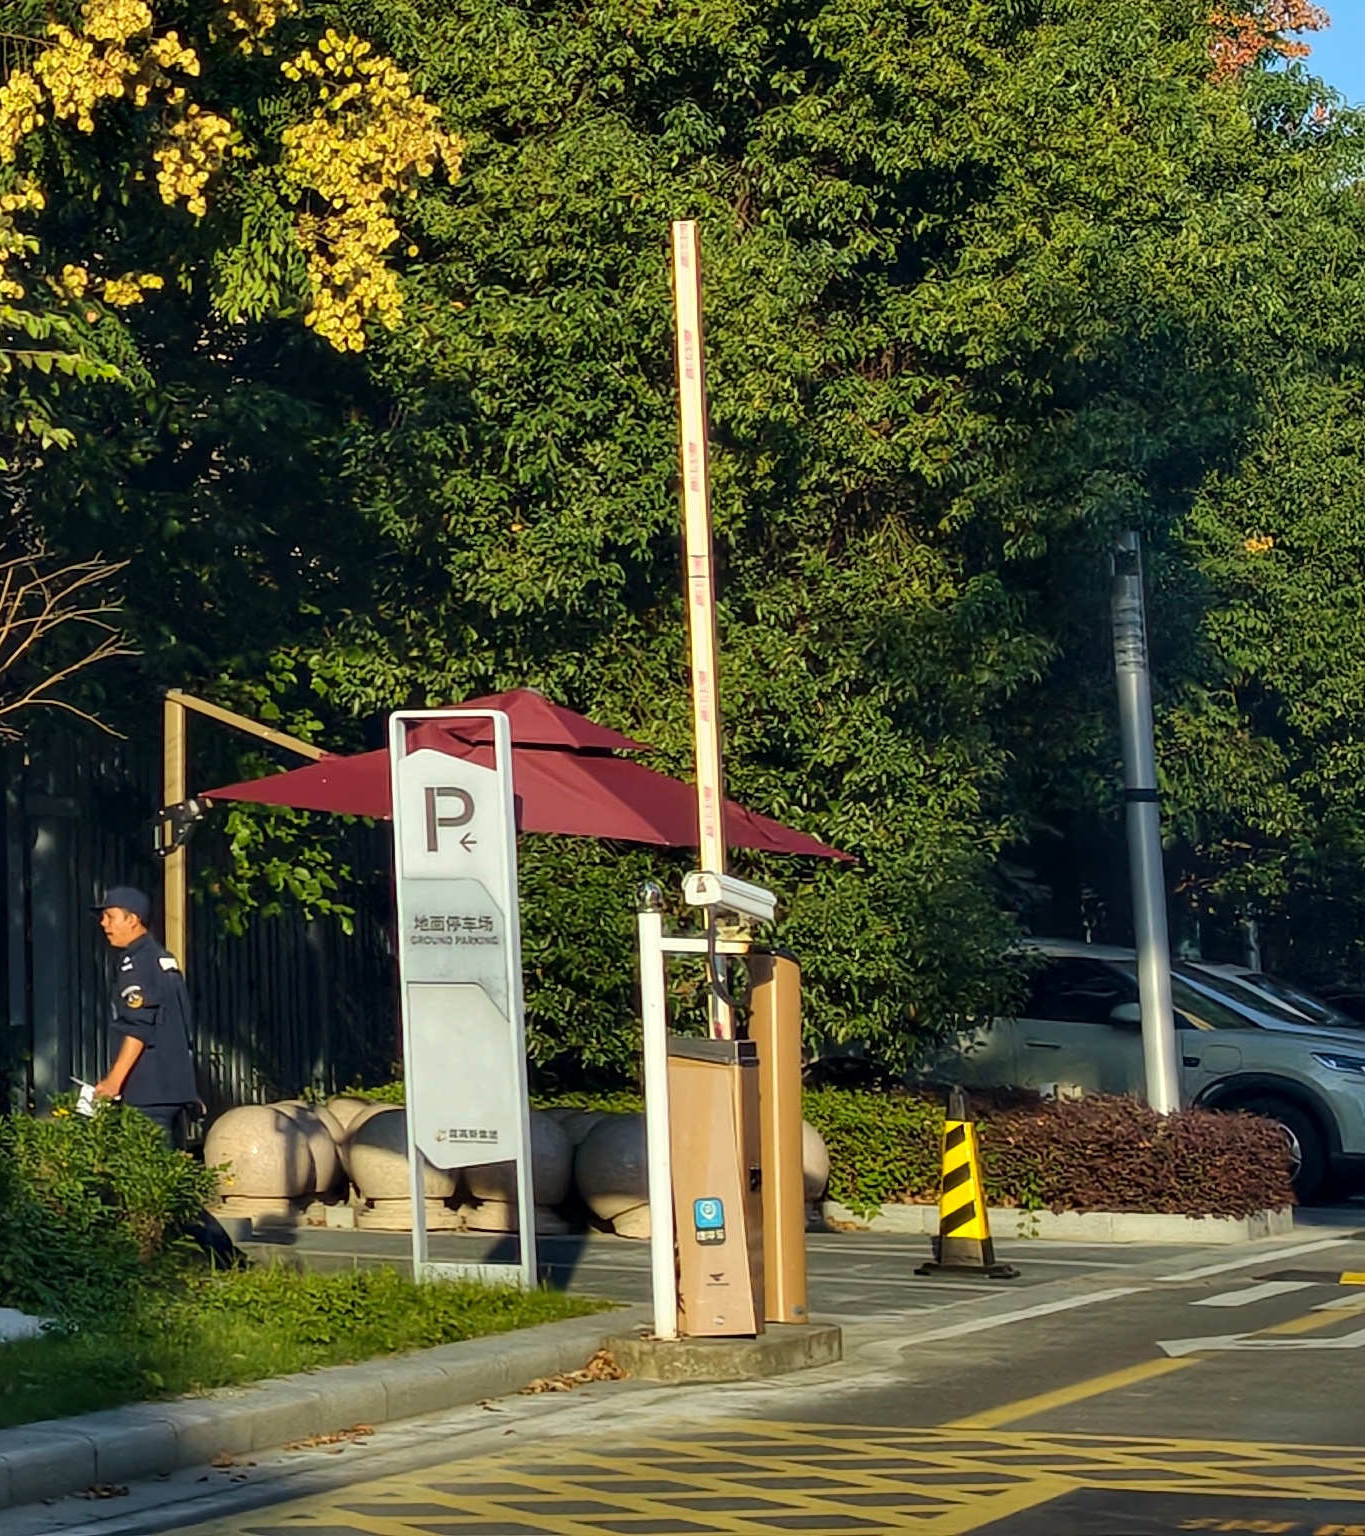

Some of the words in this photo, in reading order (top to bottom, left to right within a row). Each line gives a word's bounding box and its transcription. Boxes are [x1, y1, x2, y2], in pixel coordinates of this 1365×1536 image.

[424, 786, 475, 852] P
[414, 915, 493, 933] 地面停车场
[455, 935, 499, 945] PARKING
